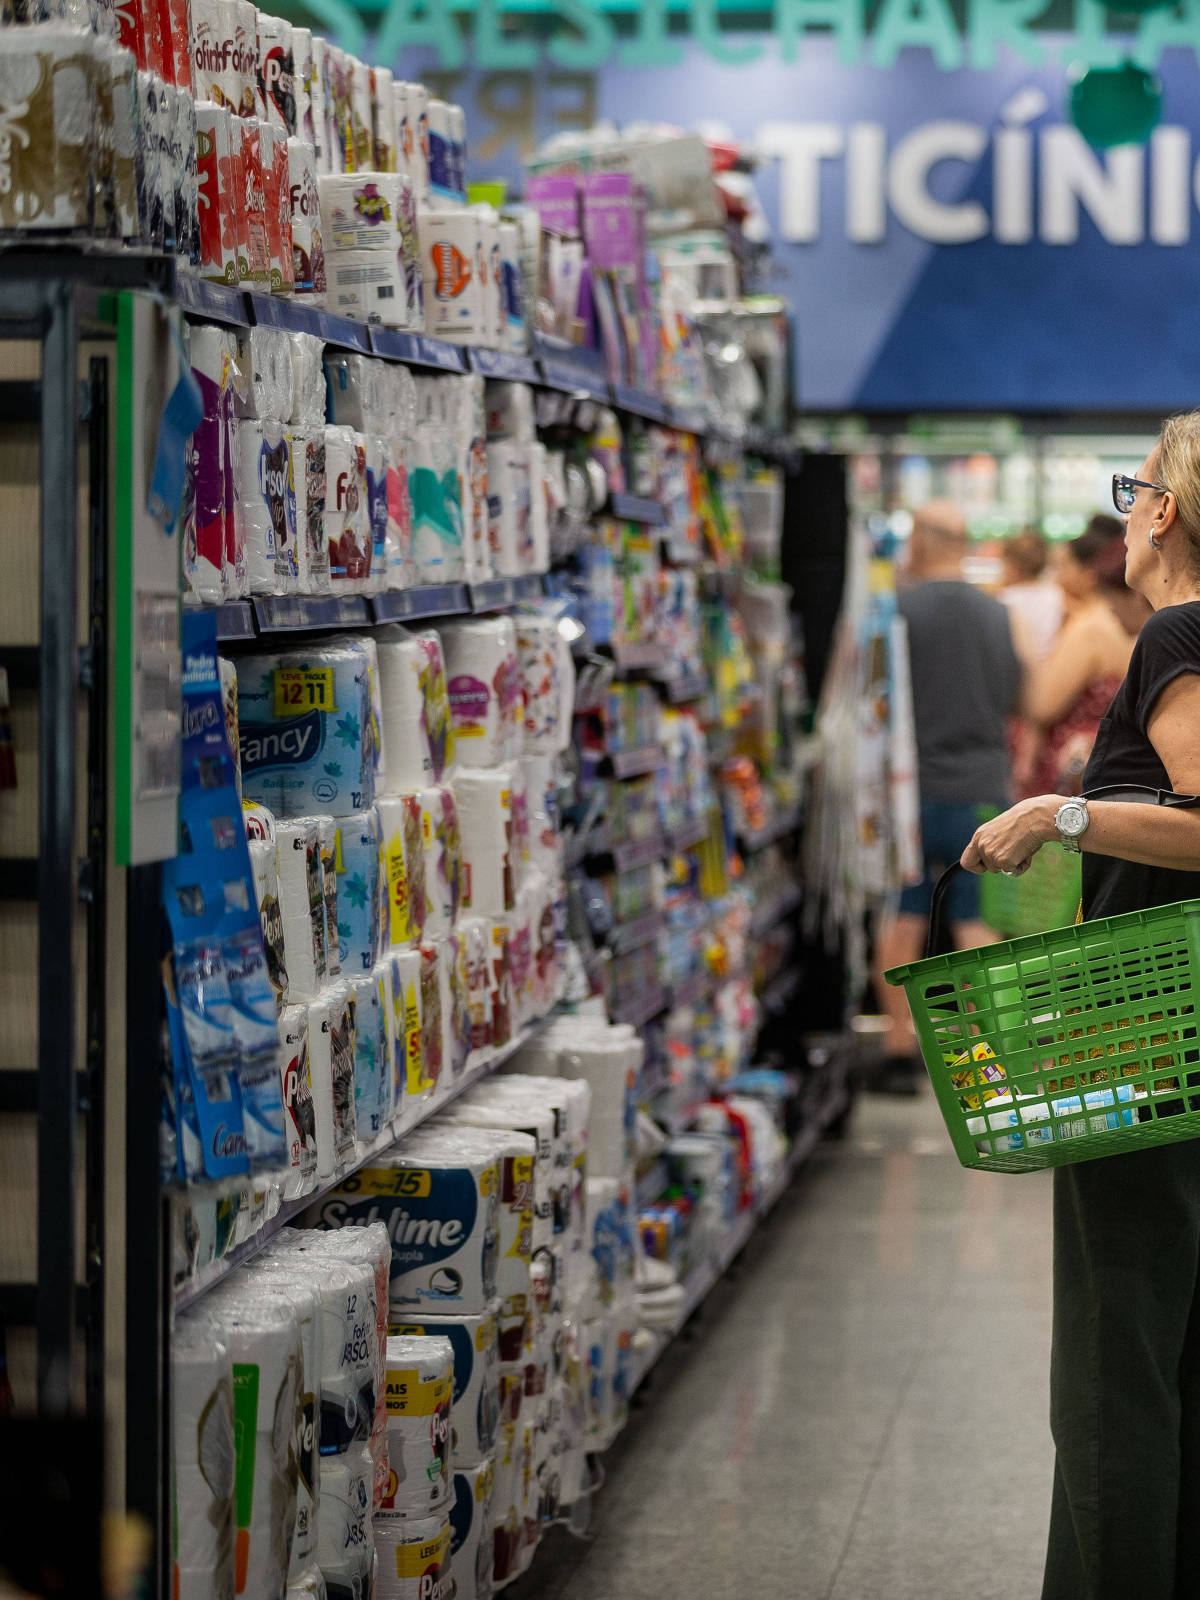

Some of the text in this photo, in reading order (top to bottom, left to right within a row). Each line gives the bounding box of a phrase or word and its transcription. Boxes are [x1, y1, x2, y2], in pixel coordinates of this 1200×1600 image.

[281, 682, 326, 705] 12 11
[239, 724, 313, 763] Fancy
[393, 1172, 424, 1194] 15
[346, 1294, 357, 1315] 12
[386, 1383, 407, 1395] AIS
